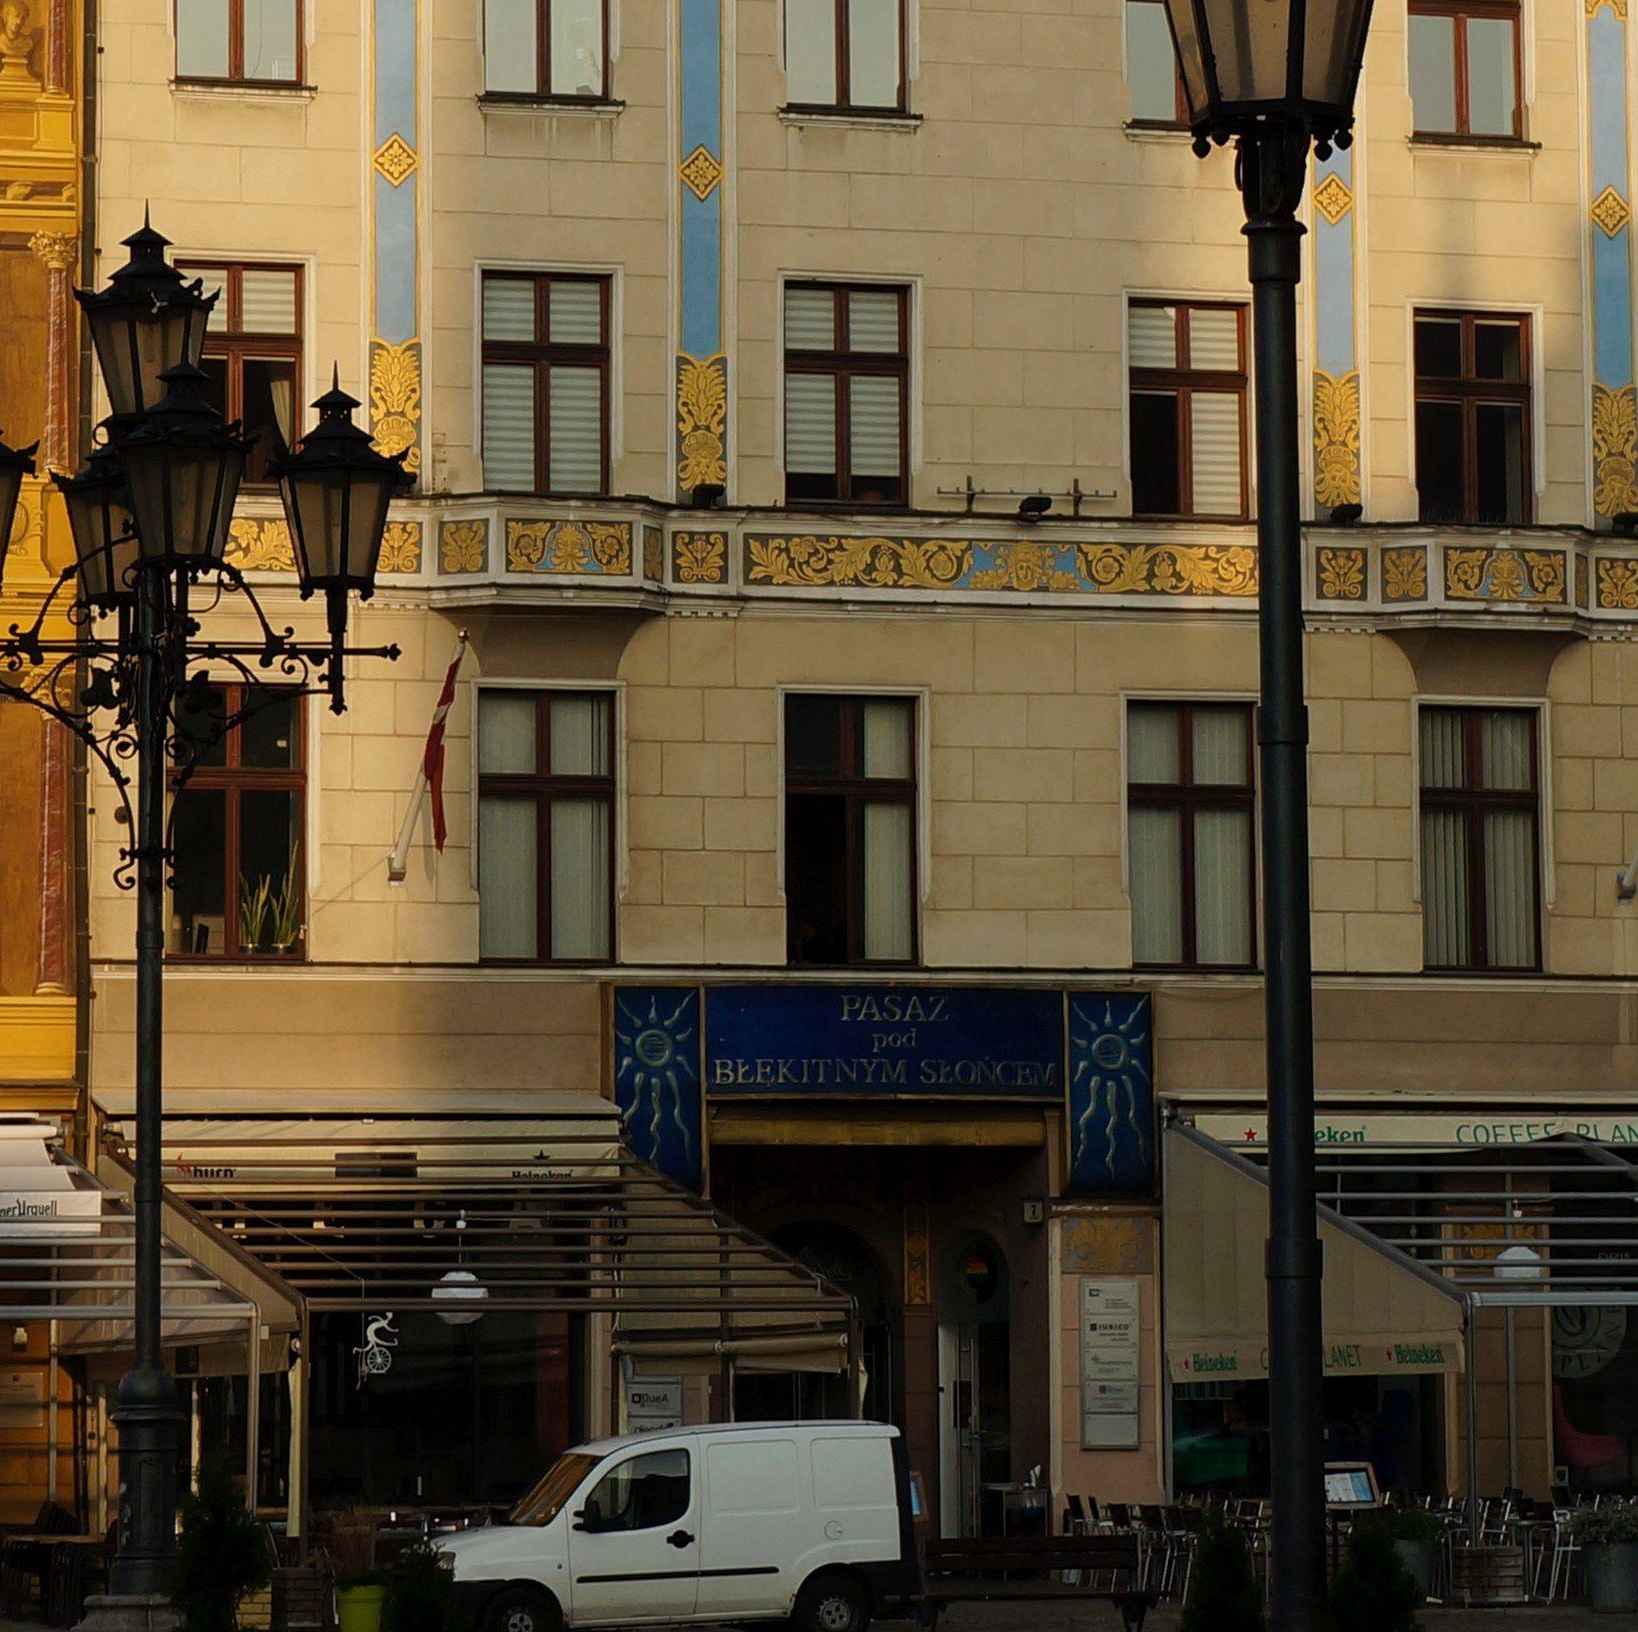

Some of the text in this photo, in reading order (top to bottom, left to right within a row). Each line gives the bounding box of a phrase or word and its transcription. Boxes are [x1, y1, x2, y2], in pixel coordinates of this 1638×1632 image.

[871, 1028, 917, 1053] pod
[714, 1056, 1058, 1087] BŁĘKITNYM SŁOŃCEM
[1323, 1343, 1362, 1368] LANET
